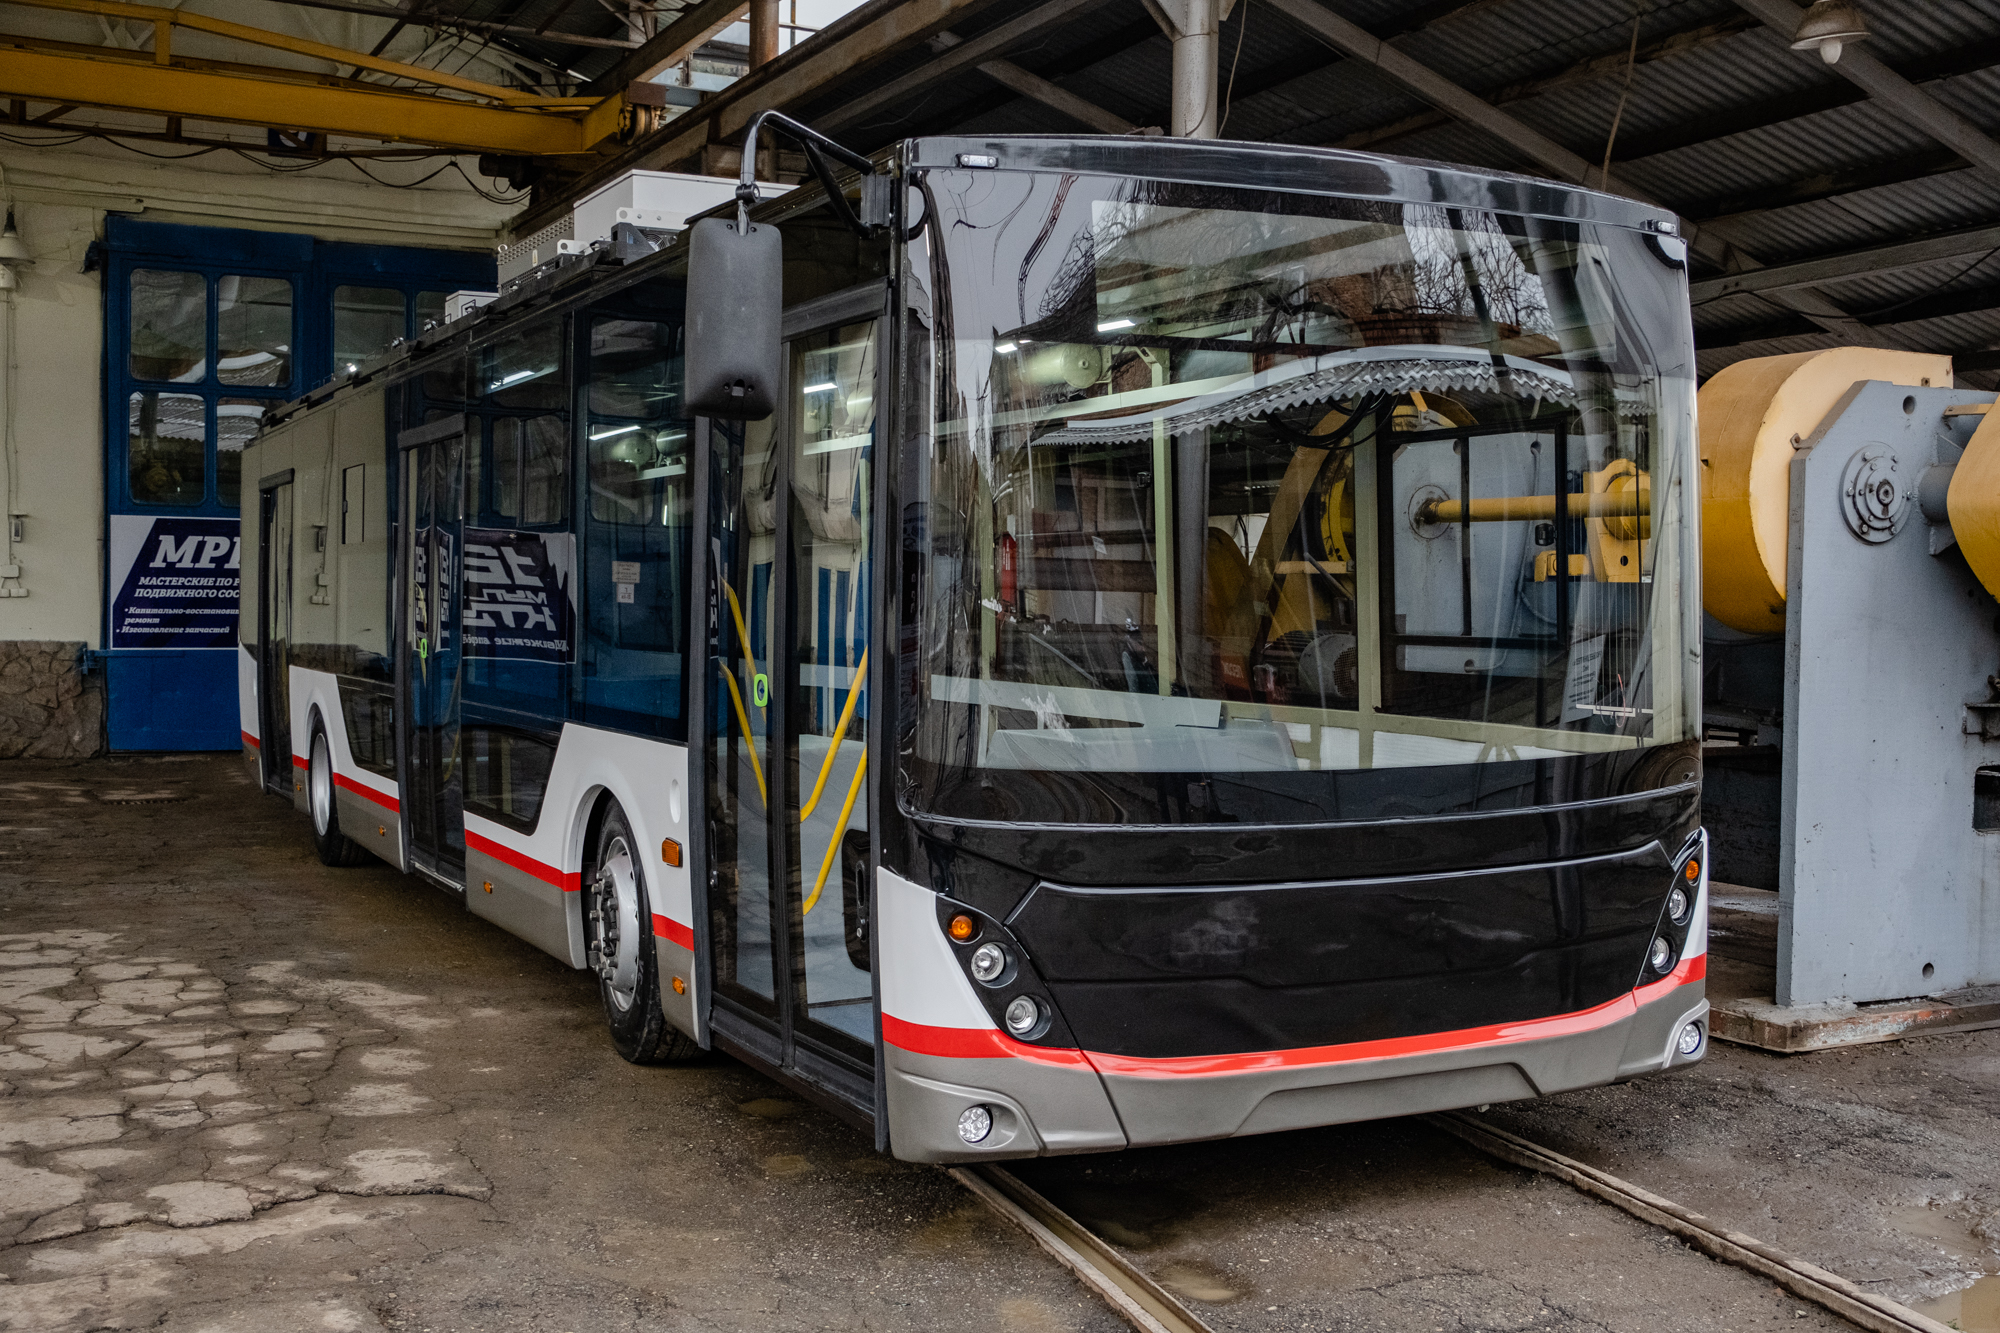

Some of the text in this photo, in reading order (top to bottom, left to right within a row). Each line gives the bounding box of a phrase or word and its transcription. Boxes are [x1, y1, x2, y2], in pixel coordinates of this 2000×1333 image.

[138, 577, 214, 586] МАСТЕРСКИЕ
[215, 578, 232, 587] ПО
[134, 588, 217, 598] ПОДВИЖНОГО
[124, 617, 160, 625] ремонт
